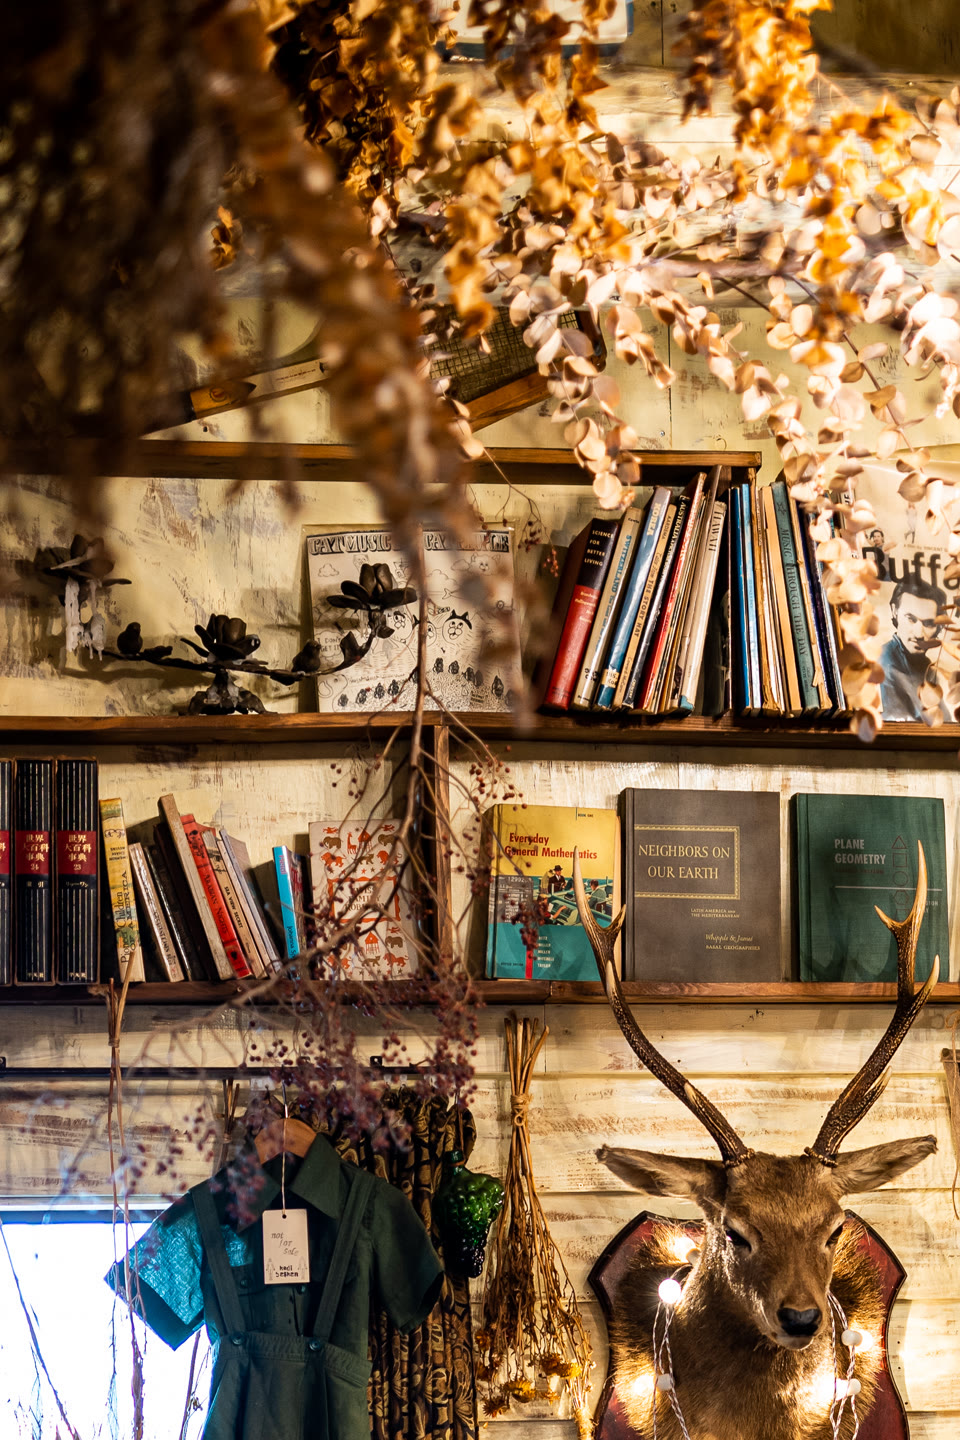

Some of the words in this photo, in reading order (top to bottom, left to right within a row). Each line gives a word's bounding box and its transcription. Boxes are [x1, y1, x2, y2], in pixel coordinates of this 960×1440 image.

[647, 503, 661, 537] KOREA
[663, 516, 672, 540] AARDEMA
[671, 502, 688, 539] AUSTRALIA
[592, 530, 614, 538] SCIENCE
[709, 511, 722, 552] HAWAII
[309, 537, 342, 554] CAT
[344, 534, 391, 552] MUSIC
[780, 527, 793, 562] MUSIC
[584, 558, 603, 566] LIVING
[611, 535, 632, 593] SWITZERLAND
[645, 580, 654, 593] THE
[785, 559, 801, 611] THROUGH
[638, 595, 650, 621] STORY
[633, 620, 643, 637] HAT
[793, 611, 804, 633] THE
[796, 633, 808, 656] DAY
[509, 832, 549, 845] Everyday
[834, 838, 864, 850] PLANE
[638, 844, 709, 858] NEIGHBORS
[712, 846, 731, 858] ON
[834, 853, 886, 865] GEOMETRY
[647, 865, 675, 878] OUR
[679, 866, 718, 879] EARTH
[115, 891, 127, 931] Children
[122, 871, 135, 929] AMERICA
[204, 873, 218, 905] ARABIAN
[217, 906, 229, 934] NIGHTS
[229, 897, 237, 912] VIEW
[286, 925, 295, 951] Johanna
[278, 1239, 292, 1248] for
